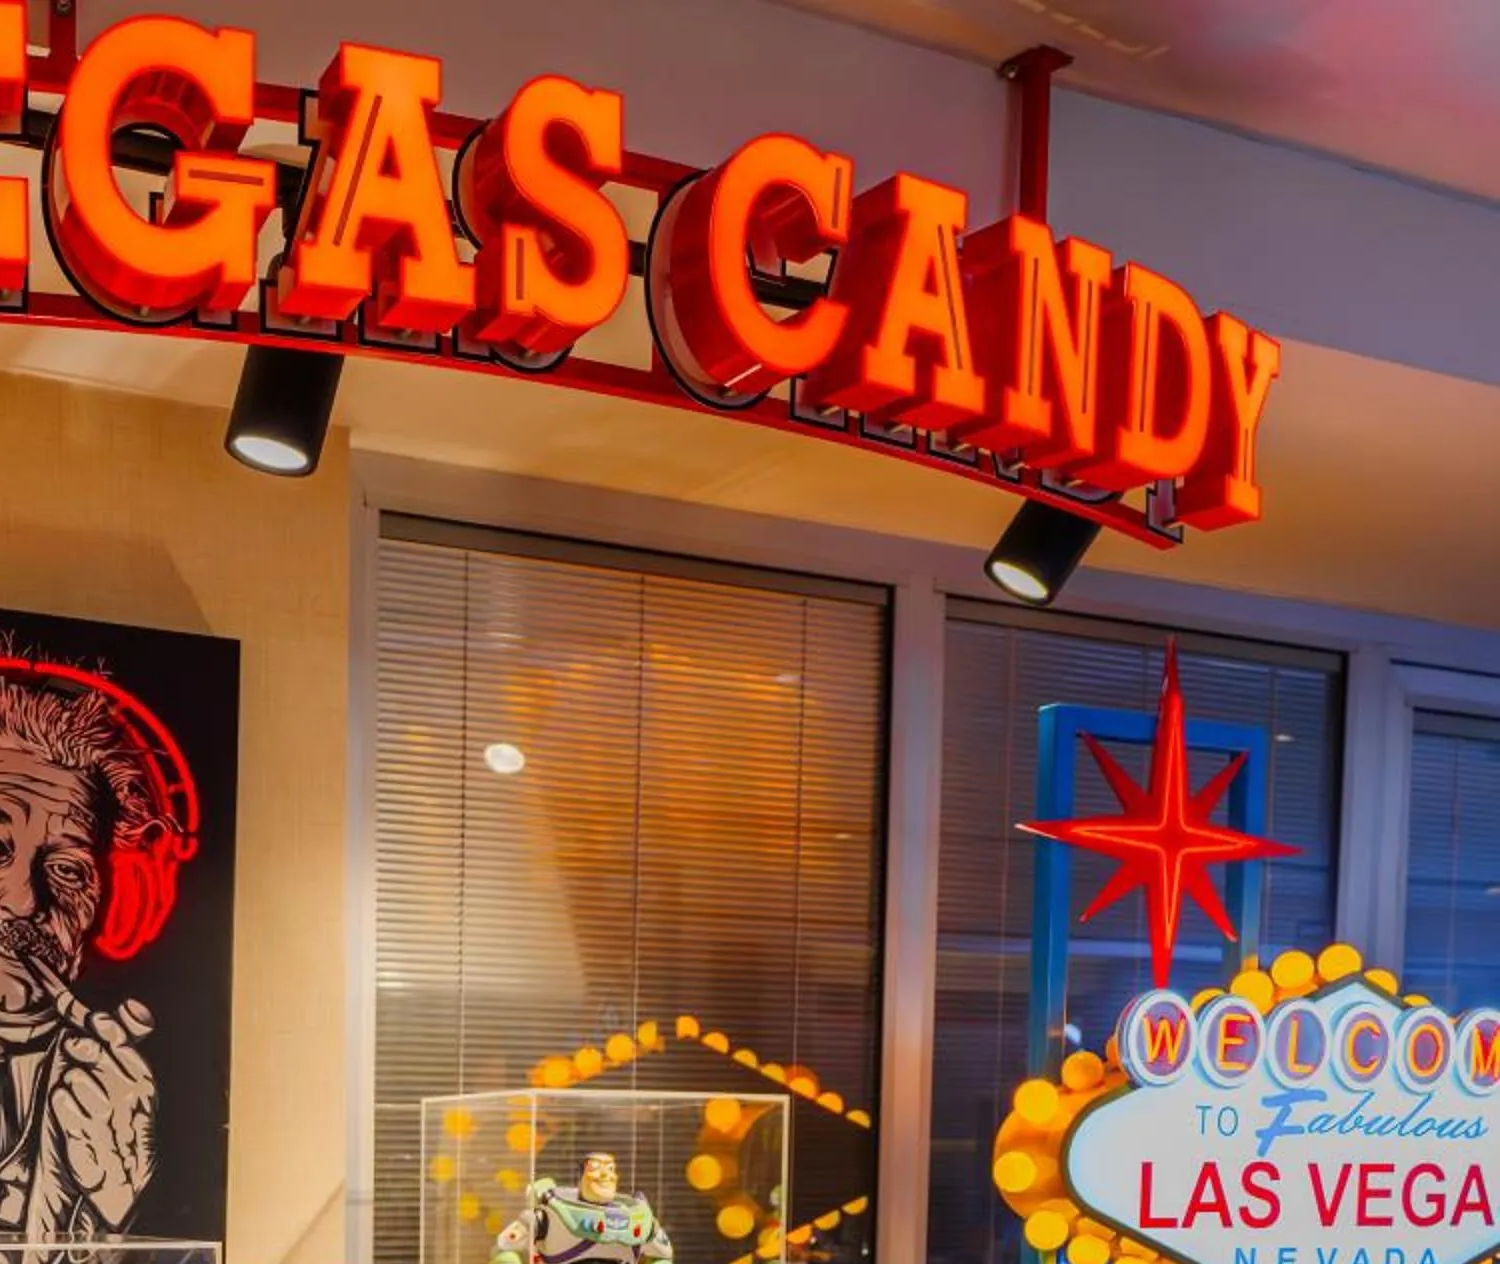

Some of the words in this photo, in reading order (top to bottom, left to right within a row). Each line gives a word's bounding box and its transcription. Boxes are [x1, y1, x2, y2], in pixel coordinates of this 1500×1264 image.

[690, 131, 1281, 530] CANDY
[1195, 1104, 1239, 1137] TO
[1255, 1088, 1489, 1157] Fabulous
[1138, 1160, 1282, 1229] LAS
[1307, 1162, 1496, 1228] VEGA
